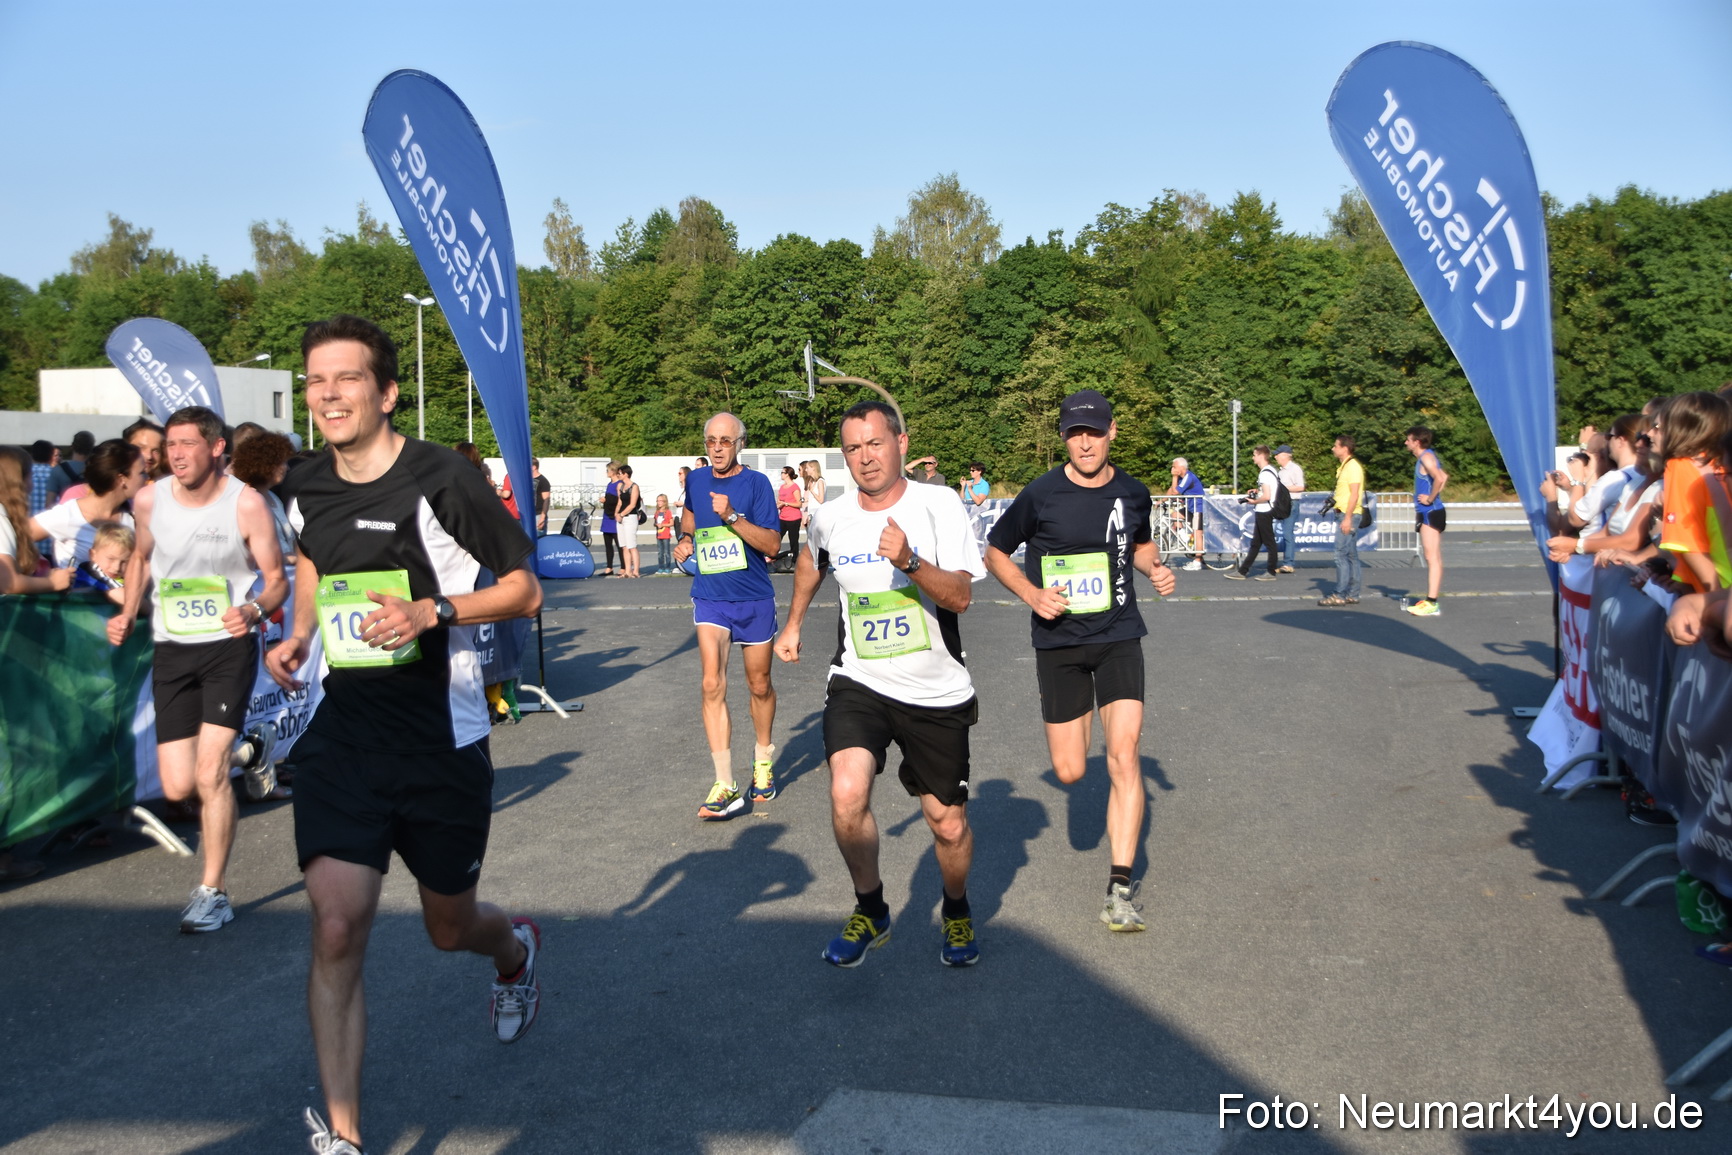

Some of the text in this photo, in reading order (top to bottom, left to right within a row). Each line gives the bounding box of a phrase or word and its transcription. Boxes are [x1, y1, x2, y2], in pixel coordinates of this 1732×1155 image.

[701, 543, 739, 561] 1494
[176, 598, 218, 619] 356
[862, 615, 911, 642] 275
[1601, 646, 1649, 722] Fischer
